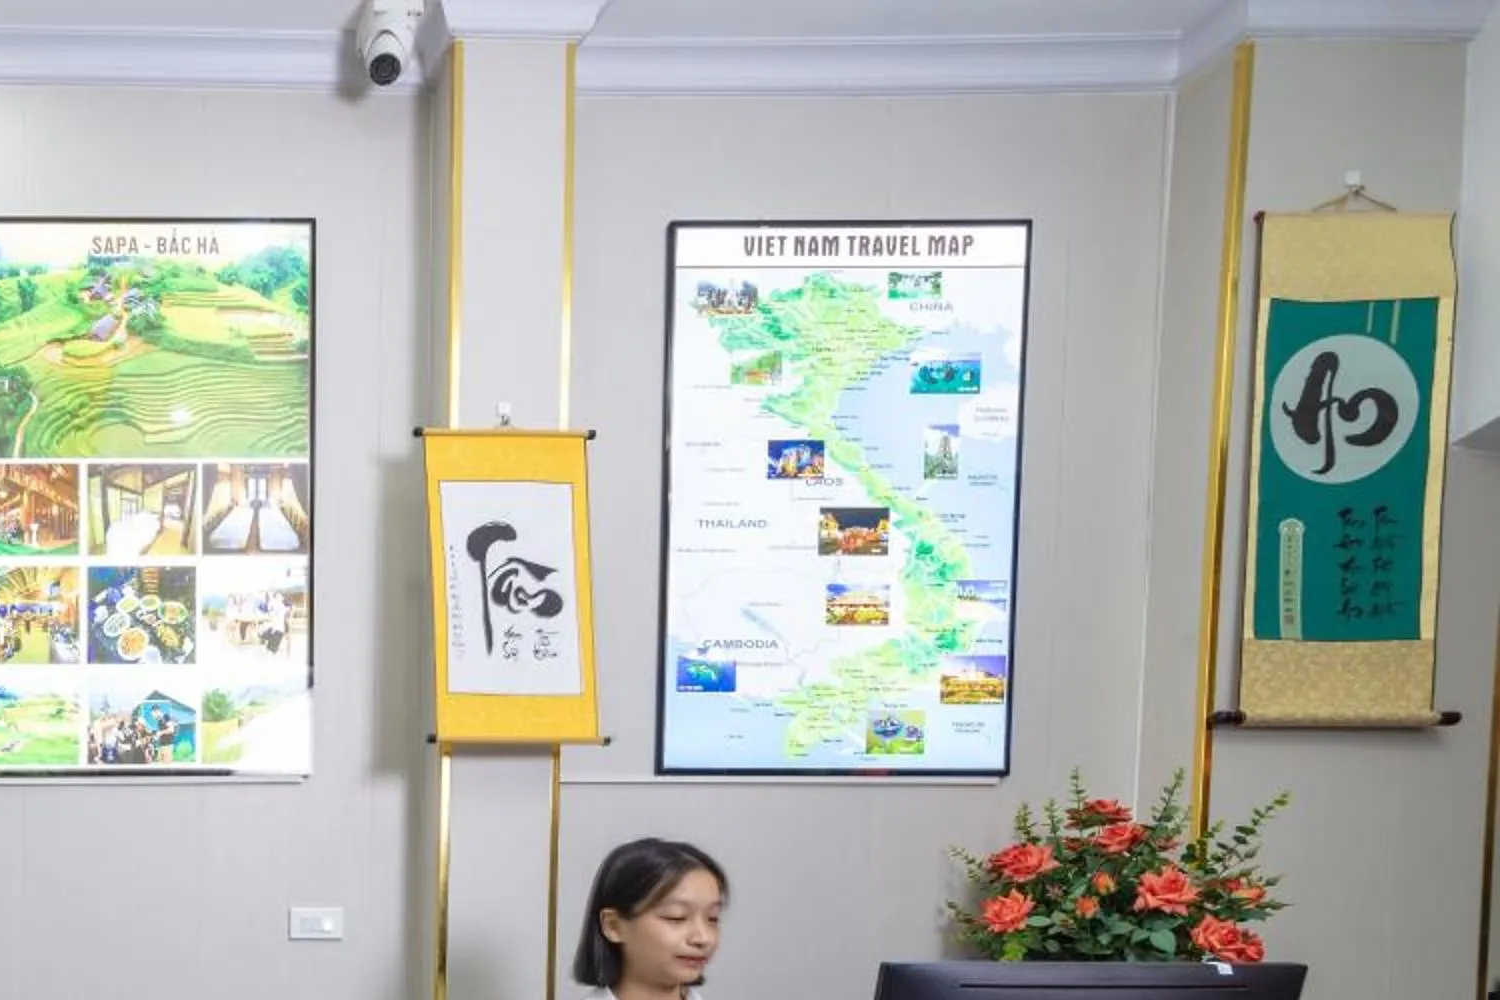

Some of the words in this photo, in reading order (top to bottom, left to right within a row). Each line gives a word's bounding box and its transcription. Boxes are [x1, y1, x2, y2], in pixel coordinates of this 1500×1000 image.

[91, 236, 139, 255] SAPA
[743, 234, 788, 257] VIET
[793, 234, 840, 257] NAM
[847, 234, 921, 257] TRAVEL
[927, 234, 975, 257] MAP
[698, 519, 769, 529] THAILAND
[702, 639, 779, 649] CAMBODIA
